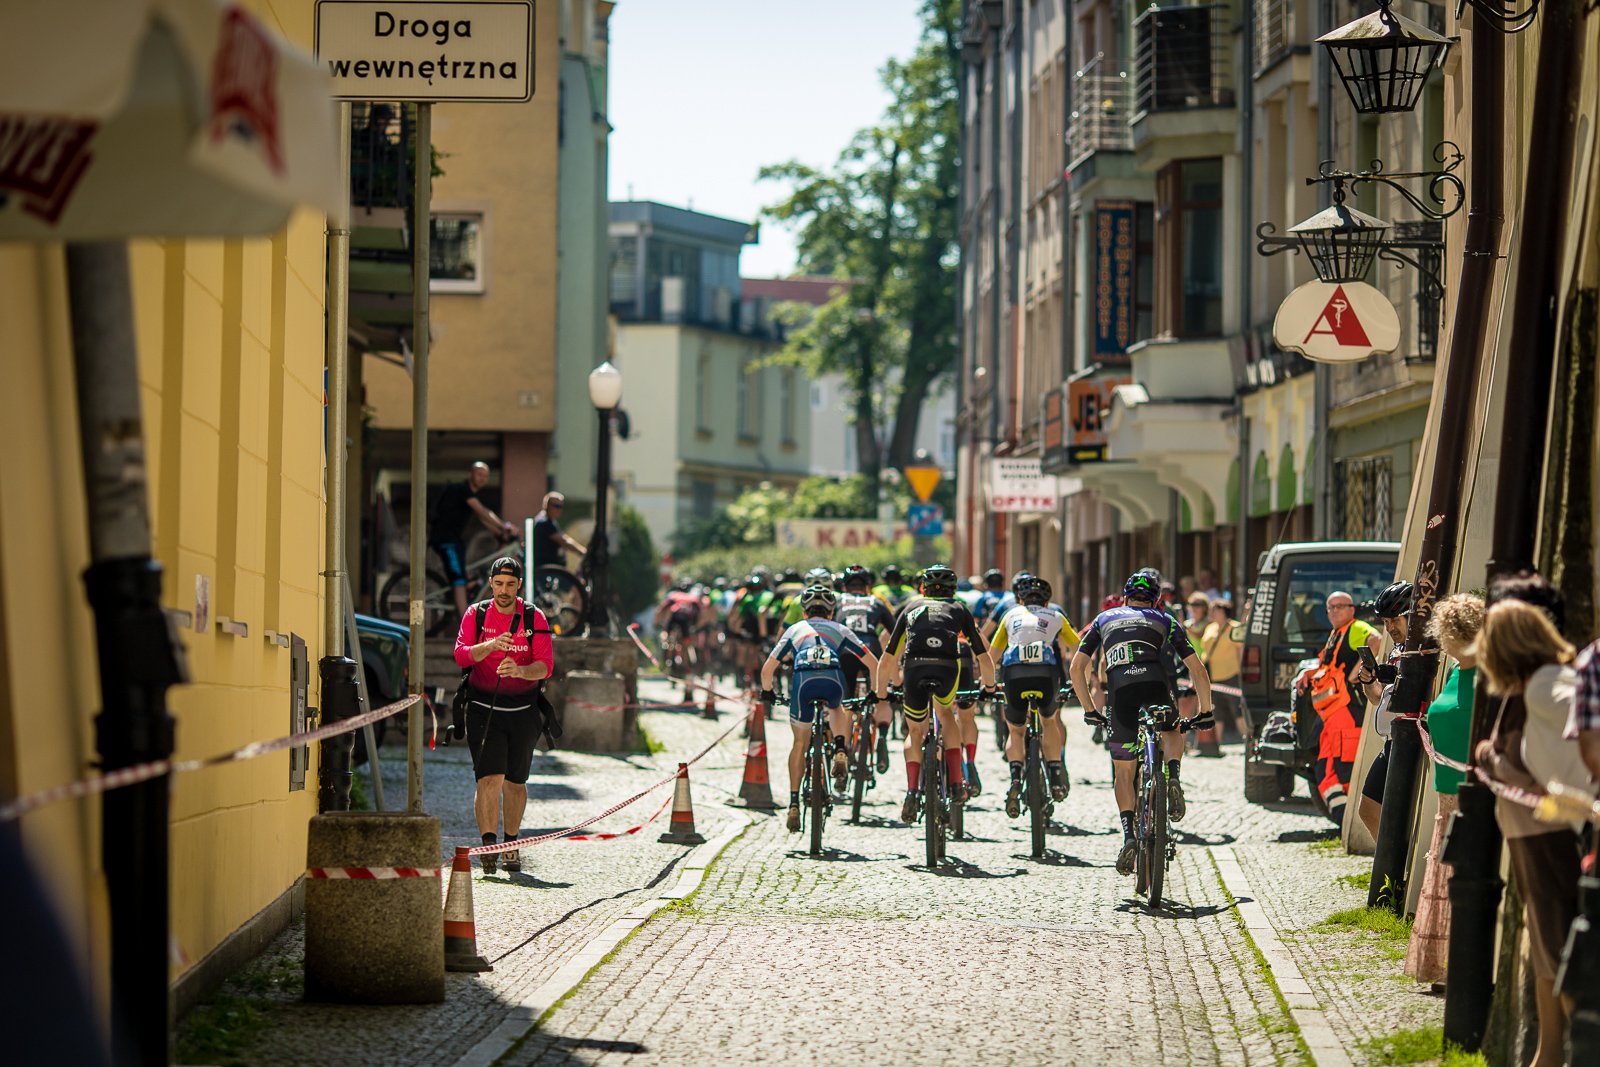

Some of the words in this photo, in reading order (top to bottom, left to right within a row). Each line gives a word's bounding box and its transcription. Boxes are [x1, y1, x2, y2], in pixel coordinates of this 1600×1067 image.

[375, 11, 472, 46] Droga
[328, 53, 517, 86] wewnętrzna
[813, 648, 825, 660] 82
[1023, 645, 1039, 659] 102
[1109, 647, 1126, 665] 100
[1123, 665, 1147, 675] Alpina
